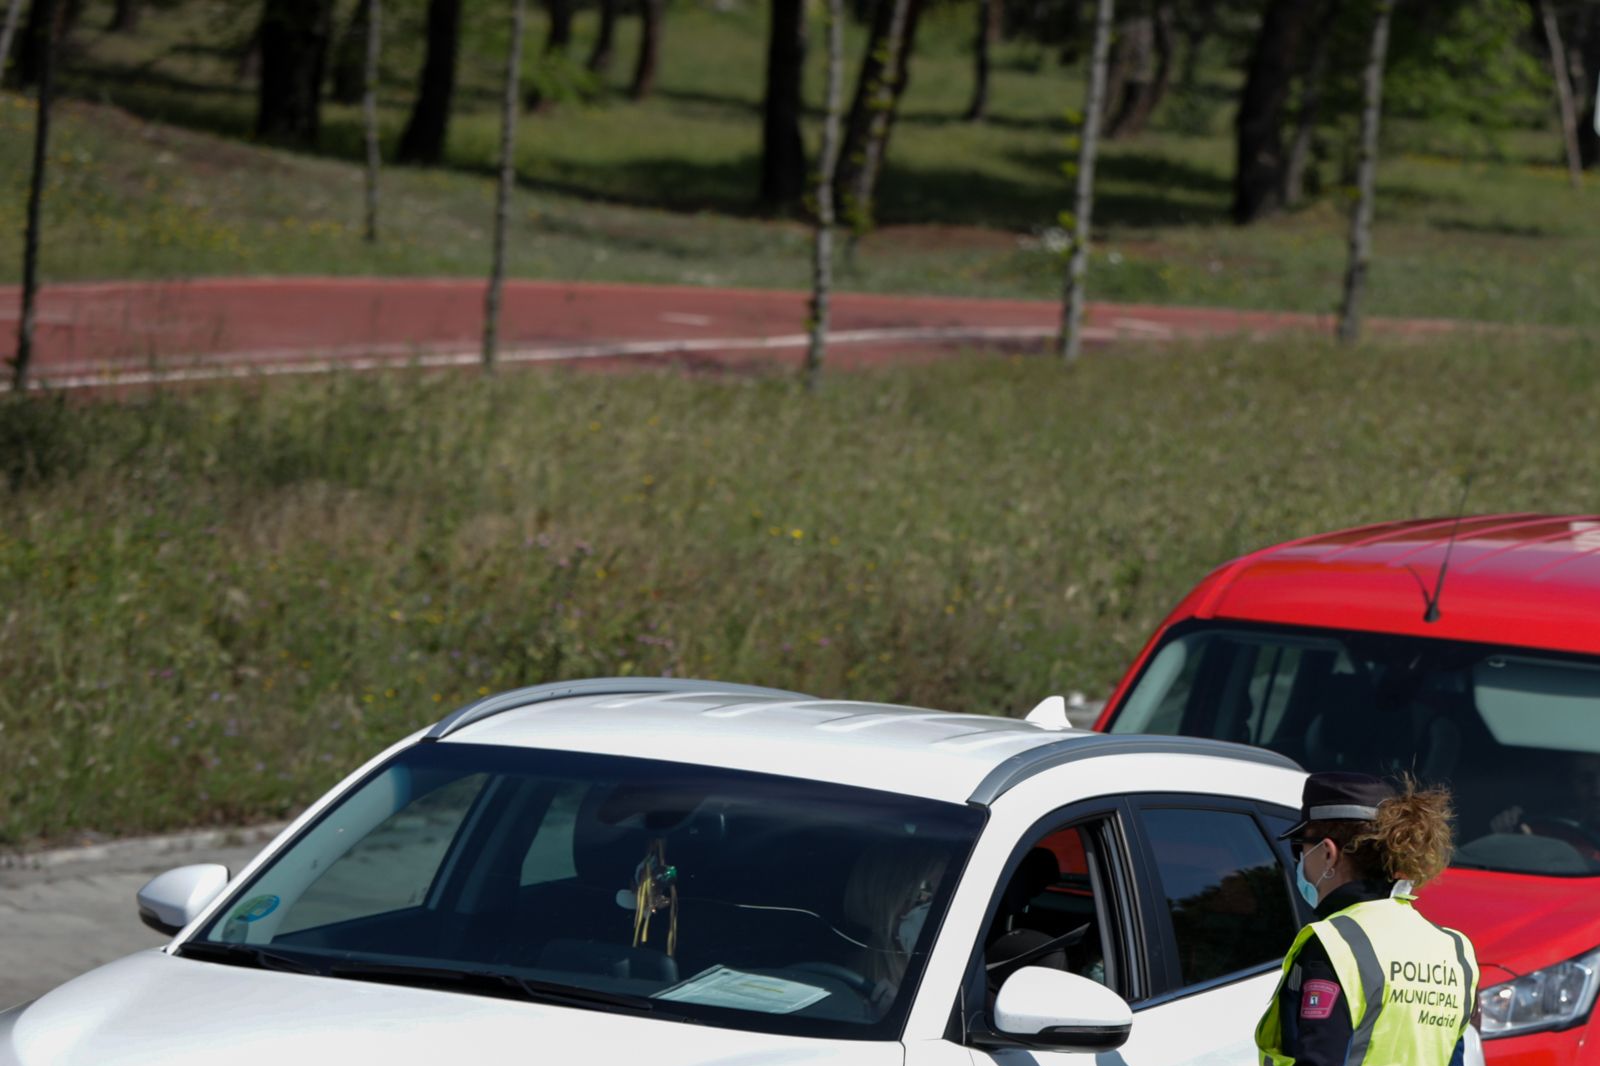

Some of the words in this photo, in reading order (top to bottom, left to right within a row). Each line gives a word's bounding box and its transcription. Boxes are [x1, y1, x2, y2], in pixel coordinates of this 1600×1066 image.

[1390, 959, 1458, 987] POLICÍA
[1389, 988, 1459, 1009] MUNICIPAL
[1417, 1009, 1457, 1028] Madrid
